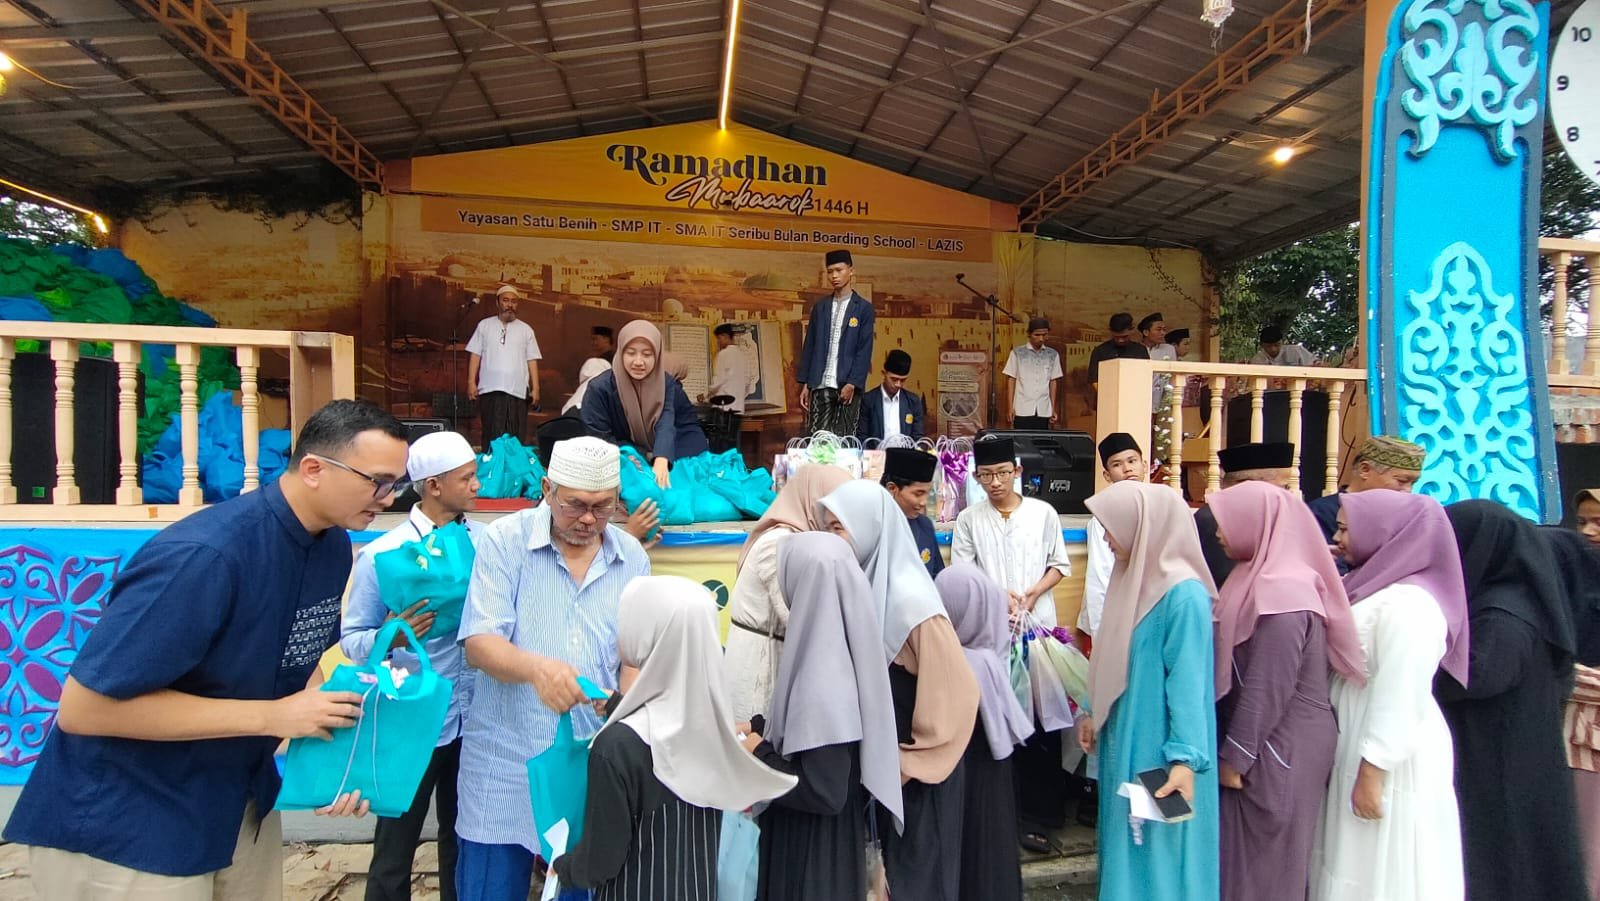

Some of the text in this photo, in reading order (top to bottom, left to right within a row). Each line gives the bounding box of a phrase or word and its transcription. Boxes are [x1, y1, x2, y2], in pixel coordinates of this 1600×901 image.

[1572, 27, 1592, 42] 10
[1556, 75, 1569, 91] 9
[1566, 126, 1579, 142] 8
[606, 144, 827, 186] Ramadhan
[665, 175, 869, 215] Mubaarok 1446 H
[458, 210, 518, 227] Yayasan
[522, 214, 554, 228] Satu
[558, 217, 598, 231] Benih
[611, 219, 645, 232] SMP
[648, 221, 662, 233] IT
[675, 223, 708, 236] SMA
[711, 225, 725, 237] IT
[728, 227, 770, 241] Seribu
[774, 229, 809, 242] Bulan
[813, 231, 869, 248] Boarding
[873, 235, 916, 249] School
[927, 238, 964, 251] LAZIS
